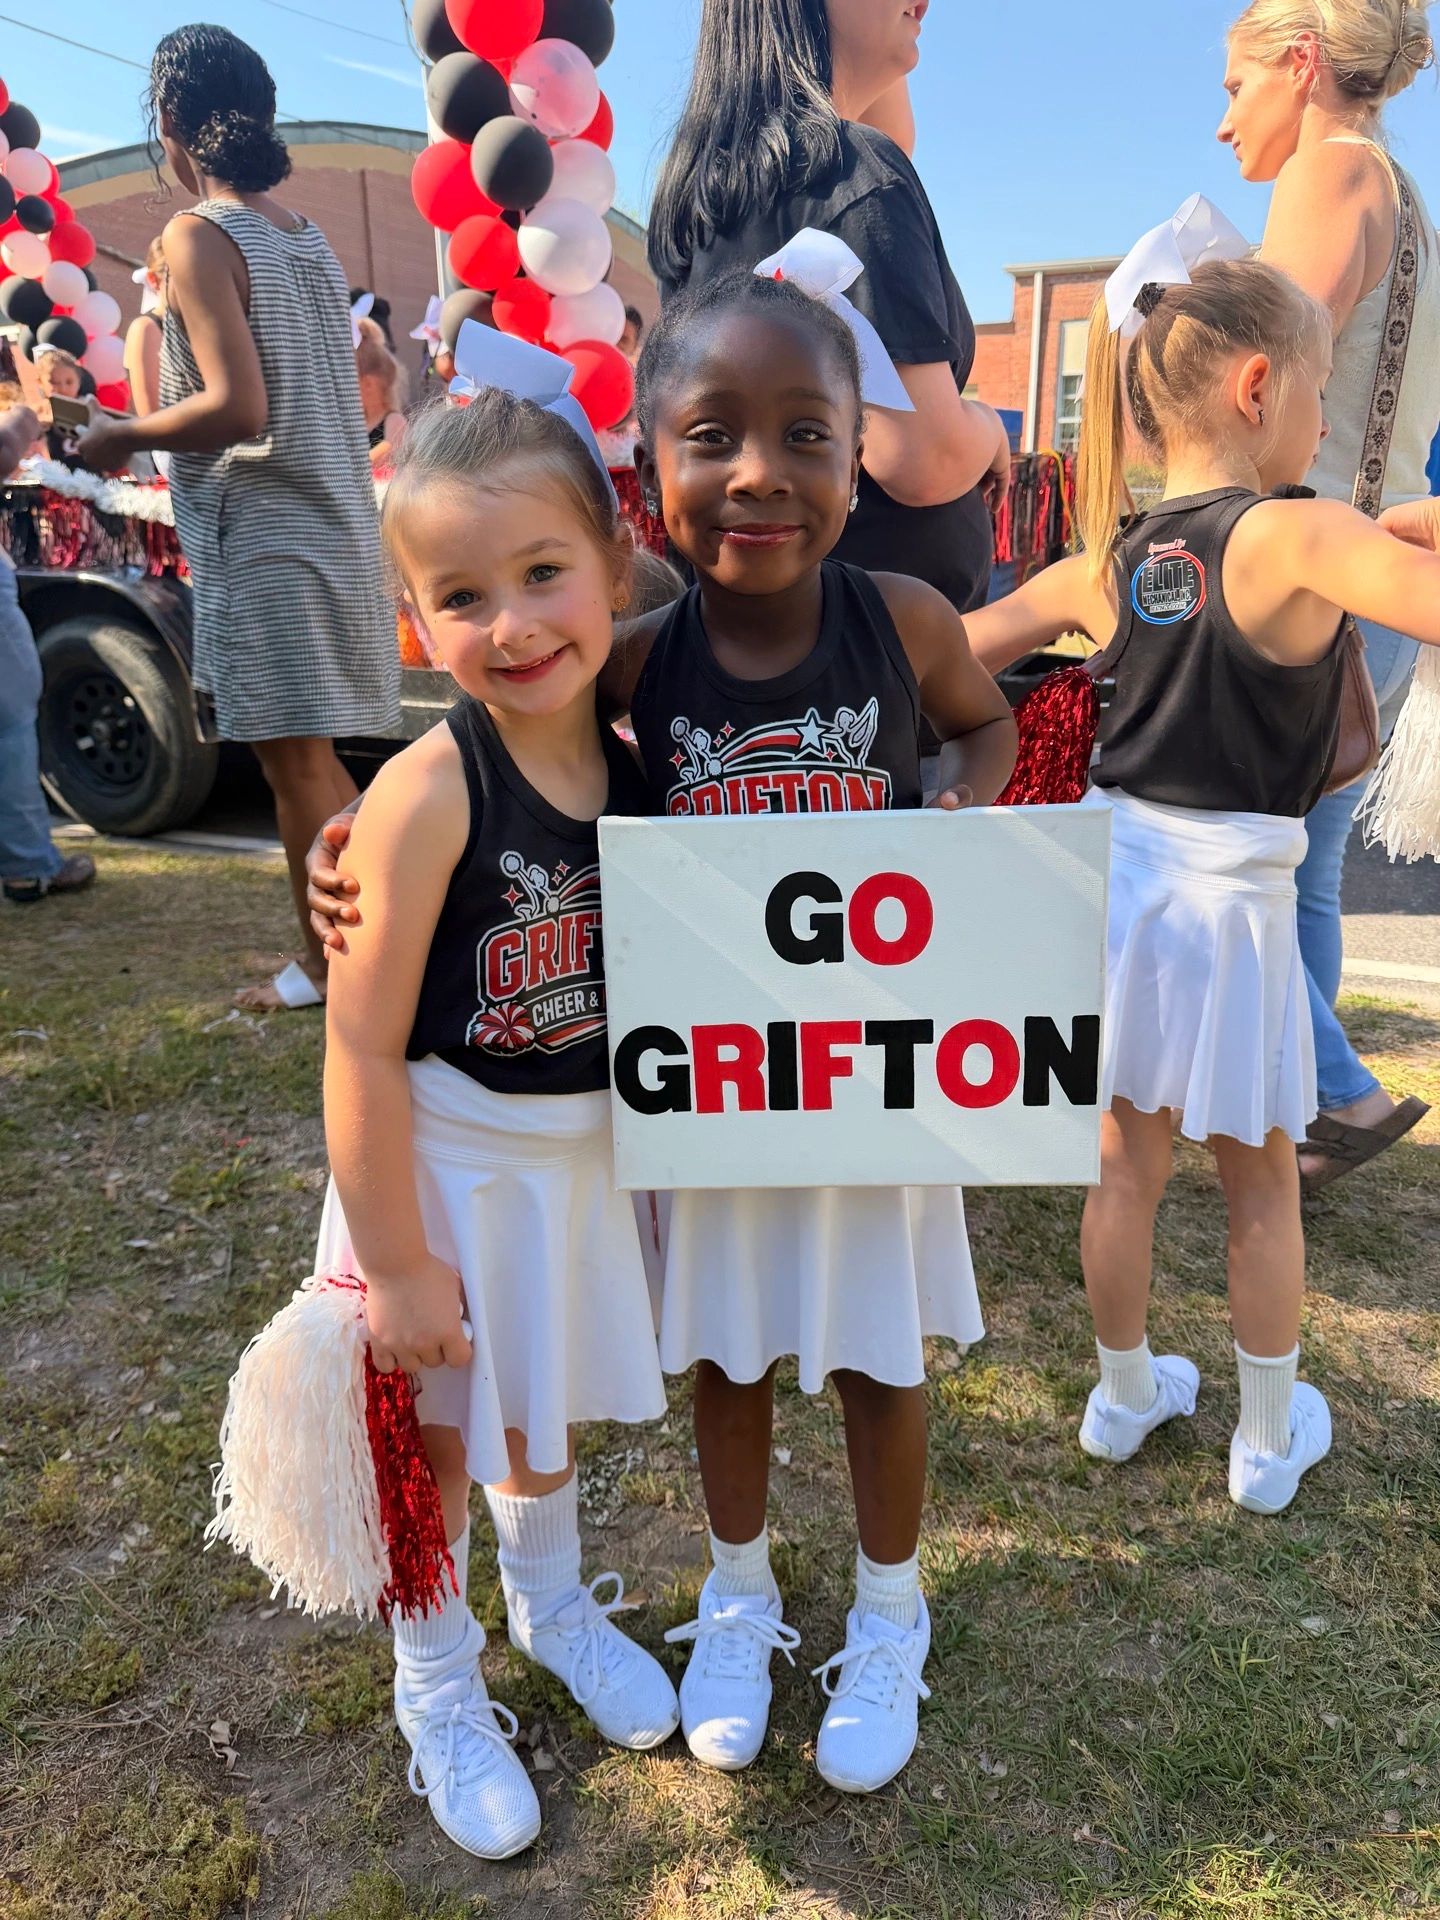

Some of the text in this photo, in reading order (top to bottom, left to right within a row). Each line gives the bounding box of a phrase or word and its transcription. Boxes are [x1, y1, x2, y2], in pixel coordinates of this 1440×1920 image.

[1142, 559, 1194, 594] ELITE
[765, 871, 934, 966] GO
[532, 989, 599, 1028] CHEER &
[613, 1014, 1101, 1115] GRIFTON
